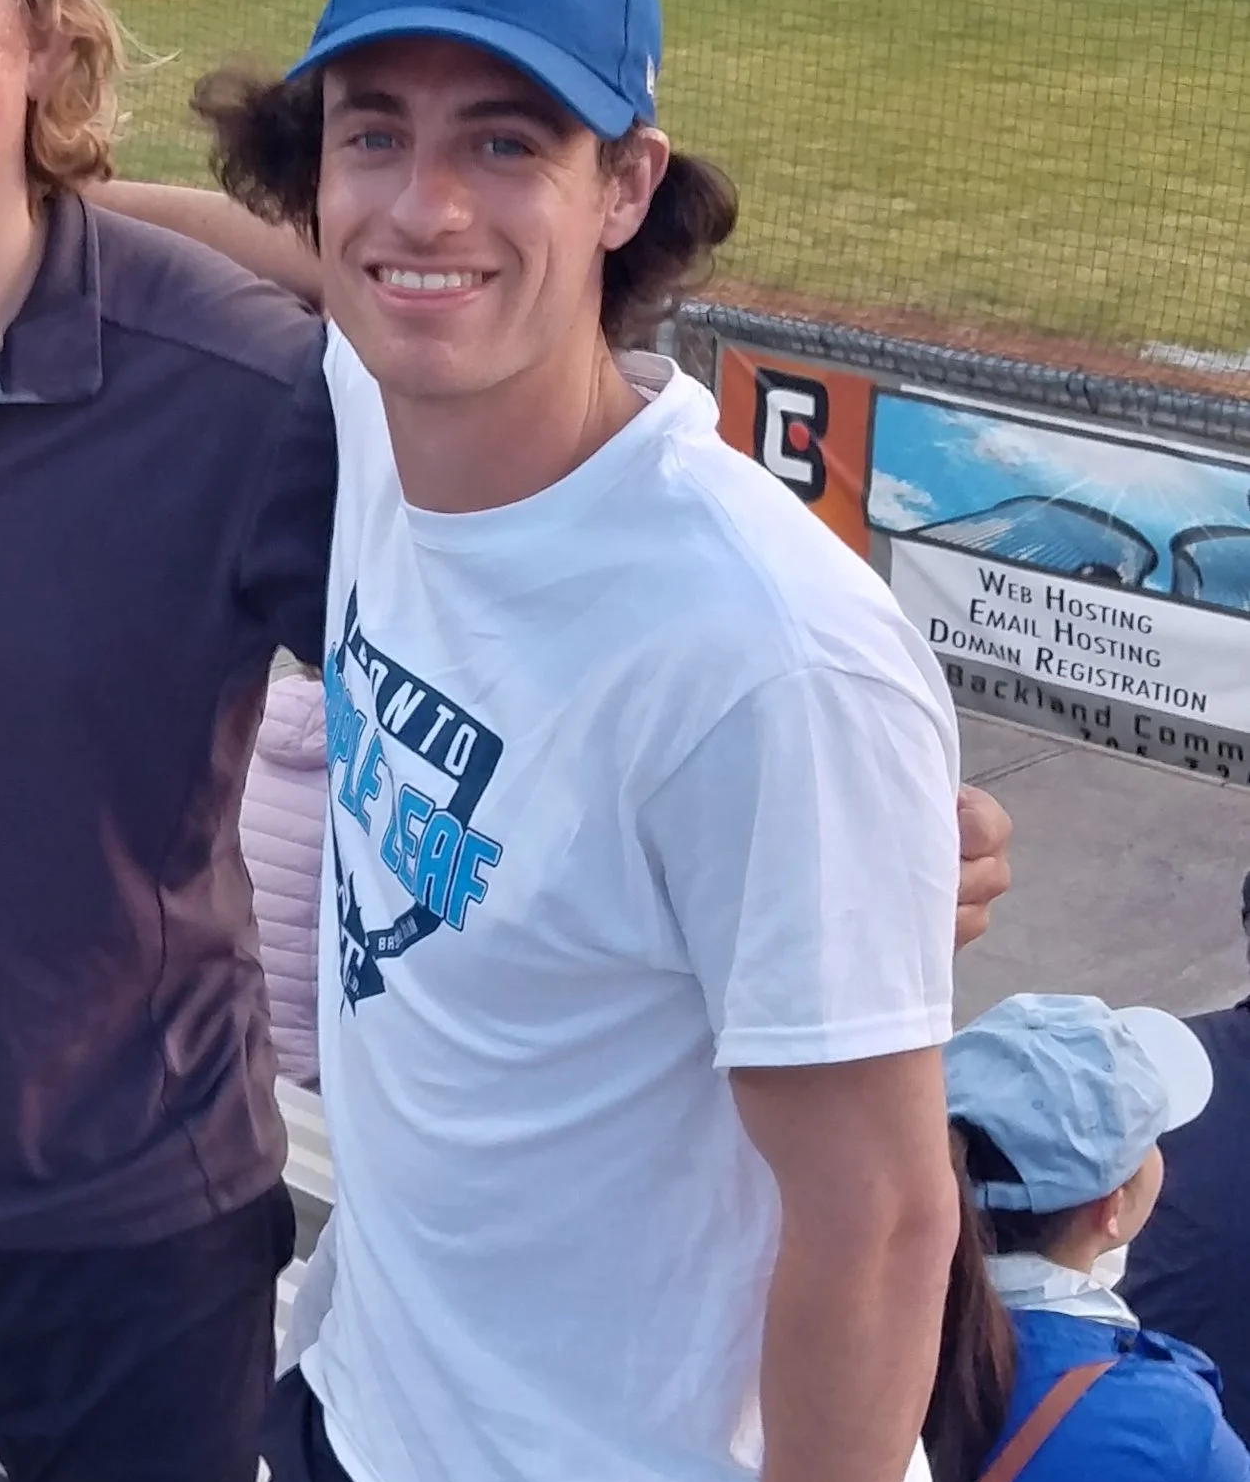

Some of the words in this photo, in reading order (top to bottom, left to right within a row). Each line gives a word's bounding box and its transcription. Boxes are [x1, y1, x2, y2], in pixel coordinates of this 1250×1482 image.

[969, 598, 1042, 639] EMAIL
[1054, 619, 1162, 668] HOSTING
[1045, 585, 1154, 635] HOSTING
[928, 617, 1022, 667] DOMAIN
[1035, 646, 1208, 713] REGISTRATION
[945, 662, 1112, 729] Backland
[379, 782, 504, 932] LEAF
